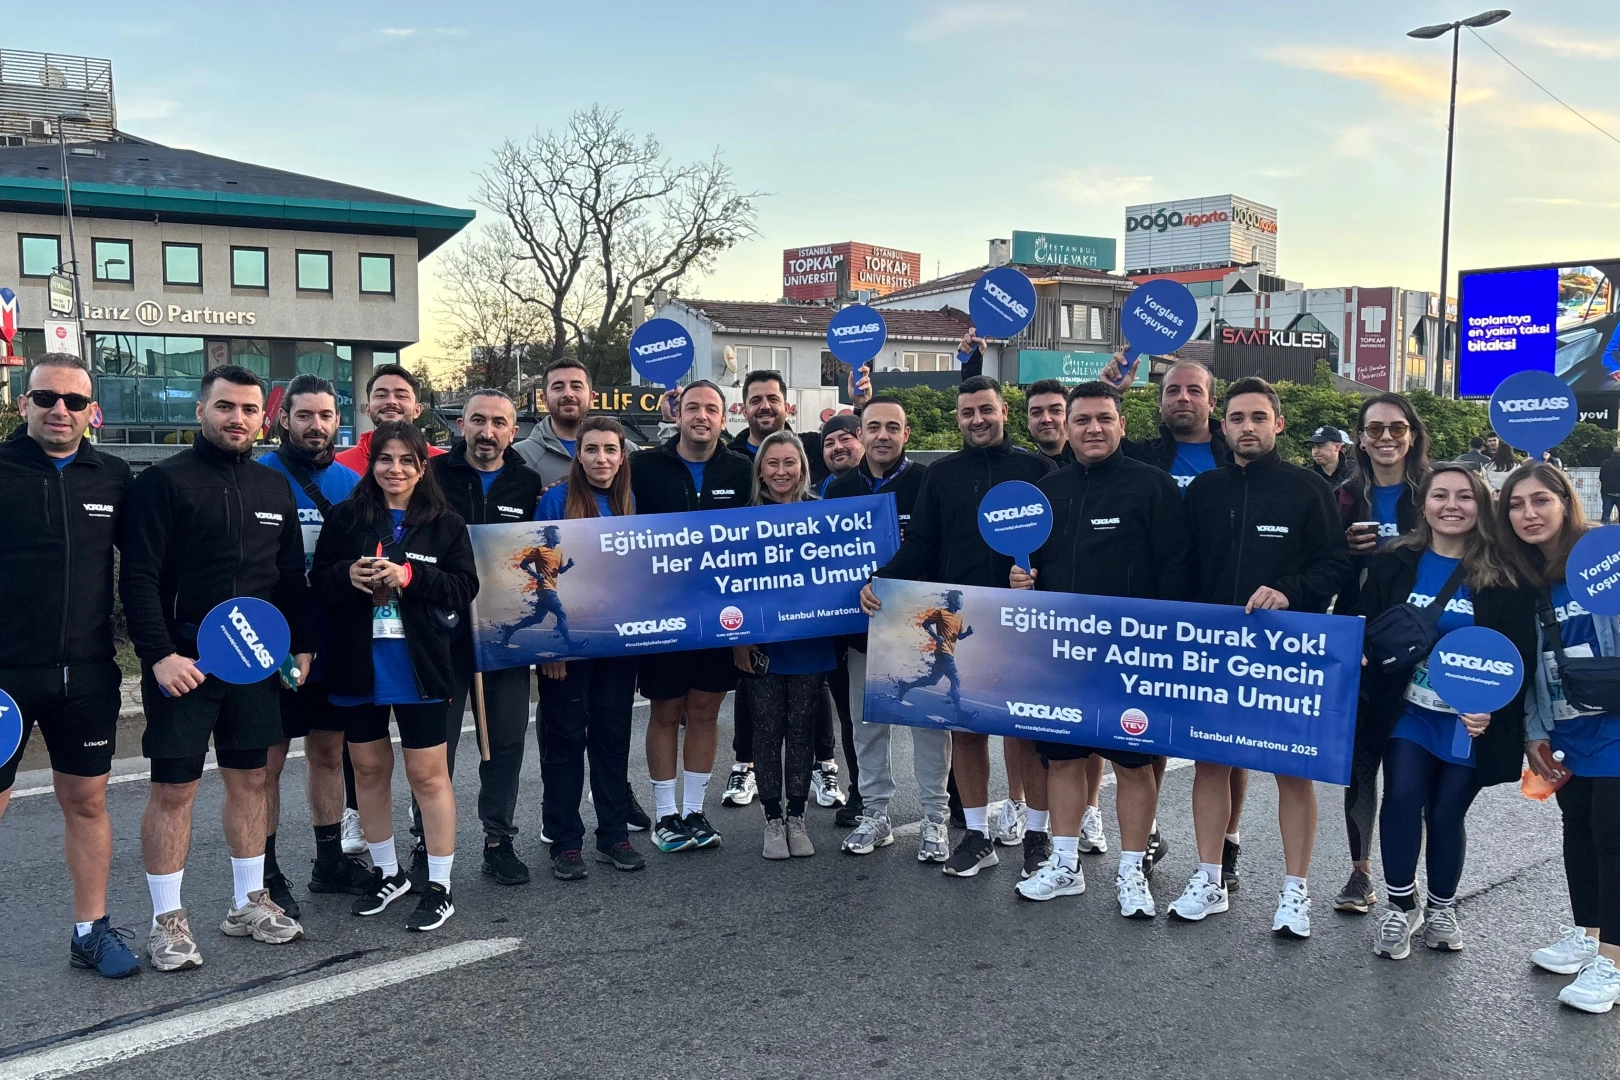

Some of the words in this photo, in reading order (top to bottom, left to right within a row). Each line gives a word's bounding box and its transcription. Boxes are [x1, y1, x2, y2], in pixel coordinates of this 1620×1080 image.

[1182, 210, 1228, 227] sigorta
[865, 256, 910, 276] TOPKAPI
[1047, 252, 1069, 265] AİLE
[1071, 255, 1097, 267] VAKFI
[860, 270, 915, 288] ÜNİVERSİTESİ
[984, 279, 1029, 318] YORGLASS
[168, 304, 256, 325] Partners
[1144, 294, 1184, 327] Yorglass
[1468, 314, 1531, 327] toplantıya
[832, 323, 880, 337] YORGLASS
[1133, 306, 1178, 339] Koşuyor!
[1468, 329, 1484, 337] en
[1485, 325, 1517, 338] yakın
[1519, 323, 1550, 335] taksi
[635, 336, 687, 356] YORGLASS
[1467, 339, 1517, 352] bitaksi
[1071, 366, 1088, 376] AİLE
[1089, 367, 1103, 376] VAK
[1498, 396, 1569, 413] YORGLASS
[1579, 409, 1609, 422] yovi
[83, 503, 114, 512] YORGLASS
[255, 512, 283, 521] YORGLASS
[497, 505, 524, 514] YORGLASS
[983, 503, 1044, 523] YORGLASS
[1090, 517, 1121, 525] YORGLASS
[1256, 525, 1289, 533] YORGLASS
[600, 529, 703, 556] Eğitimde
[710, 524, 750, 543] Dur
[756, 517, 820, 539] Durak
[825, 511, 872, 533] Yok!
[405, 552, 437, 564] YORGLASS
[652, 554, 692, 574] Her
[700, 549, 757, 570] Adım
[764, 543, 794, 564] Bir
[800, 537, 876, 560] Gencin
[1579, 550, 1620, 581] Yorgla
[714, 572, 805, 594] Yarınına
[1586, 571, 1620, 597] Koşu
[778, 610, 814, 622] İstanbul
[817, 607, 860, 619] Maratonu
[228, 605, 275, 668] YORGLASS
[614, 617, 687, 637] YORGLASS
[1000, 606, 1112, 636] Eğitimde
[1121, 617, 1167, 640] Dur
[1176, 621, 1257, 649] Durak
[1264, 629, 1327, 656] Yok!
[1052, 639, 1097, 662] Her
[1105, 644, 1173, 669] Adım
[1183, 650, 1219, 673] Bir
[1227, 656, 1325, 685] Gencin
[1438, 651, 1514, 676] YORGLASS
[1121, 673, 1228, 704] Yarınına
[1237, 686, 1321, 716] Umut!
[1006, 701, 1082, 723] YORGLASS
[1124, 721, 1146, 730] TEV
[1190, 726, 1233, 744] İstanbul
[1236, 735, 1288, 752] Maratonu
[1291, 743, 1318, 757] 2025
